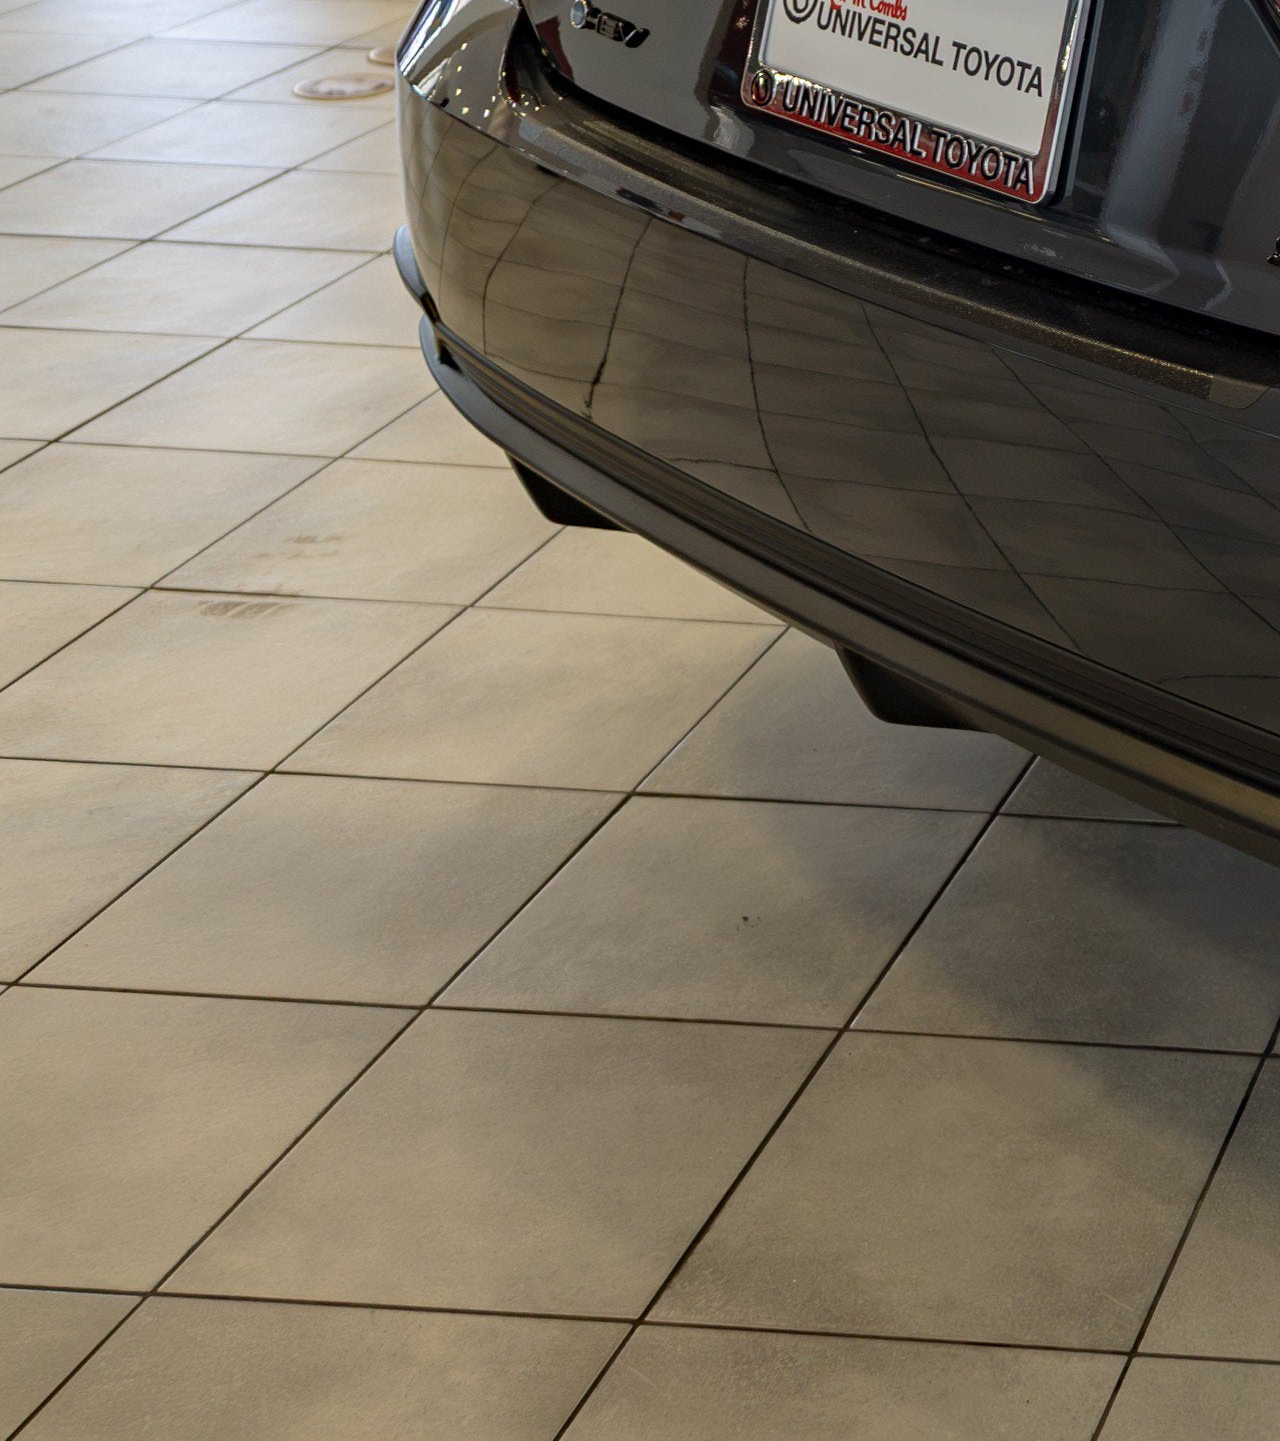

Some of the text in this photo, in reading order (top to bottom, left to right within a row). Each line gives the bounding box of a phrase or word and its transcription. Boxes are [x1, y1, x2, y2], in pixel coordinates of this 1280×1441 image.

[816, 0, 1044, 98] UNIVERSAL TOYOTA
[782, 76, 1036, 196] UNIVERSAL TOYOTA
